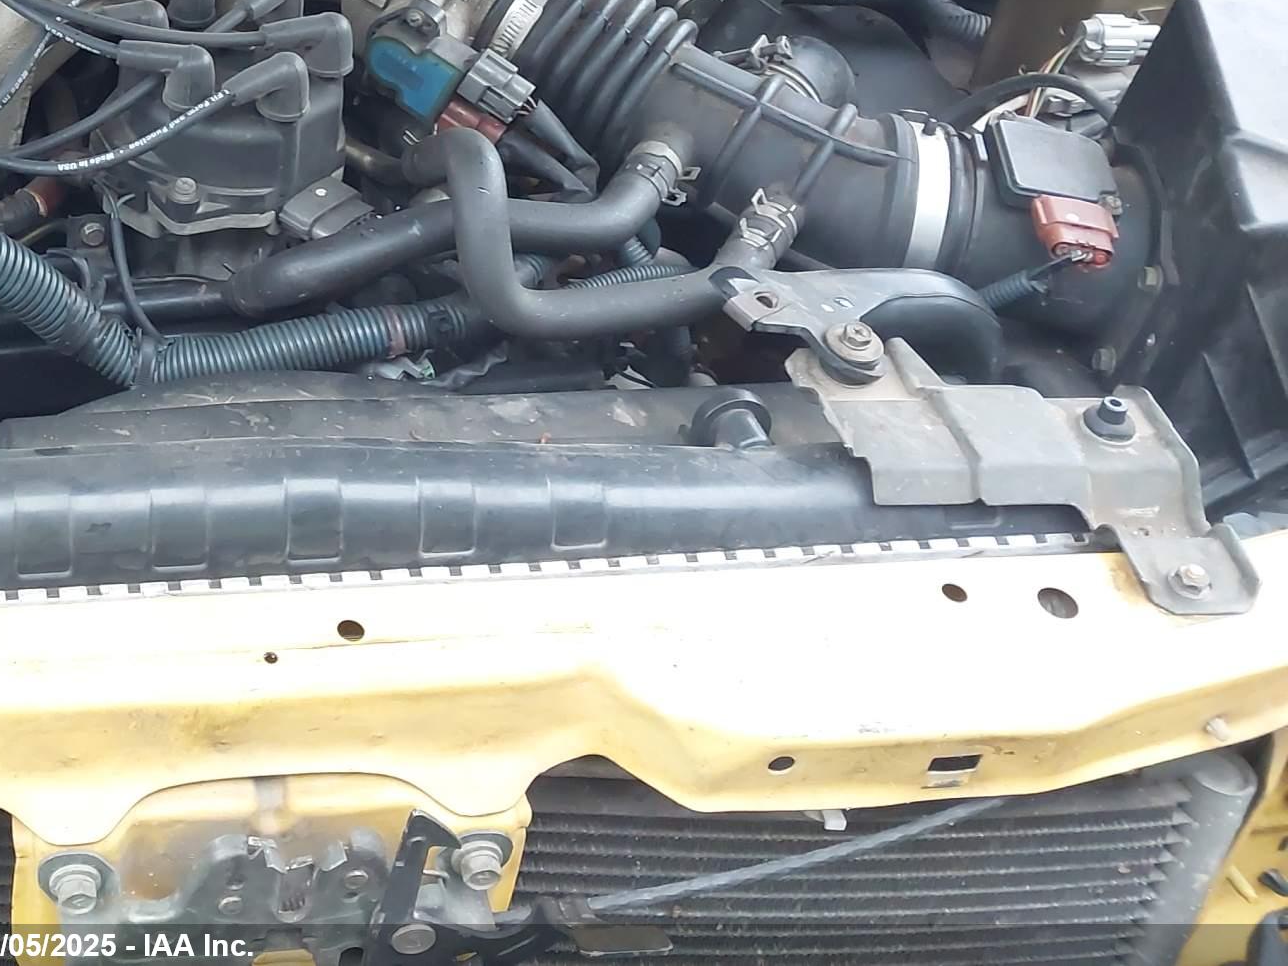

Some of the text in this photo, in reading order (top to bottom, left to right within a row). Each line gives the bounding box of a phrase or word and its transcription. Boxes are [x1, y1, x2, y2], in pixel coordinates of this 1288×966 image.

[169, 115, 186, 128] and
[128, 126, 169, 150] Function
[90, 151, 115, 165] Made
[57, 162, 78, 172] USA
